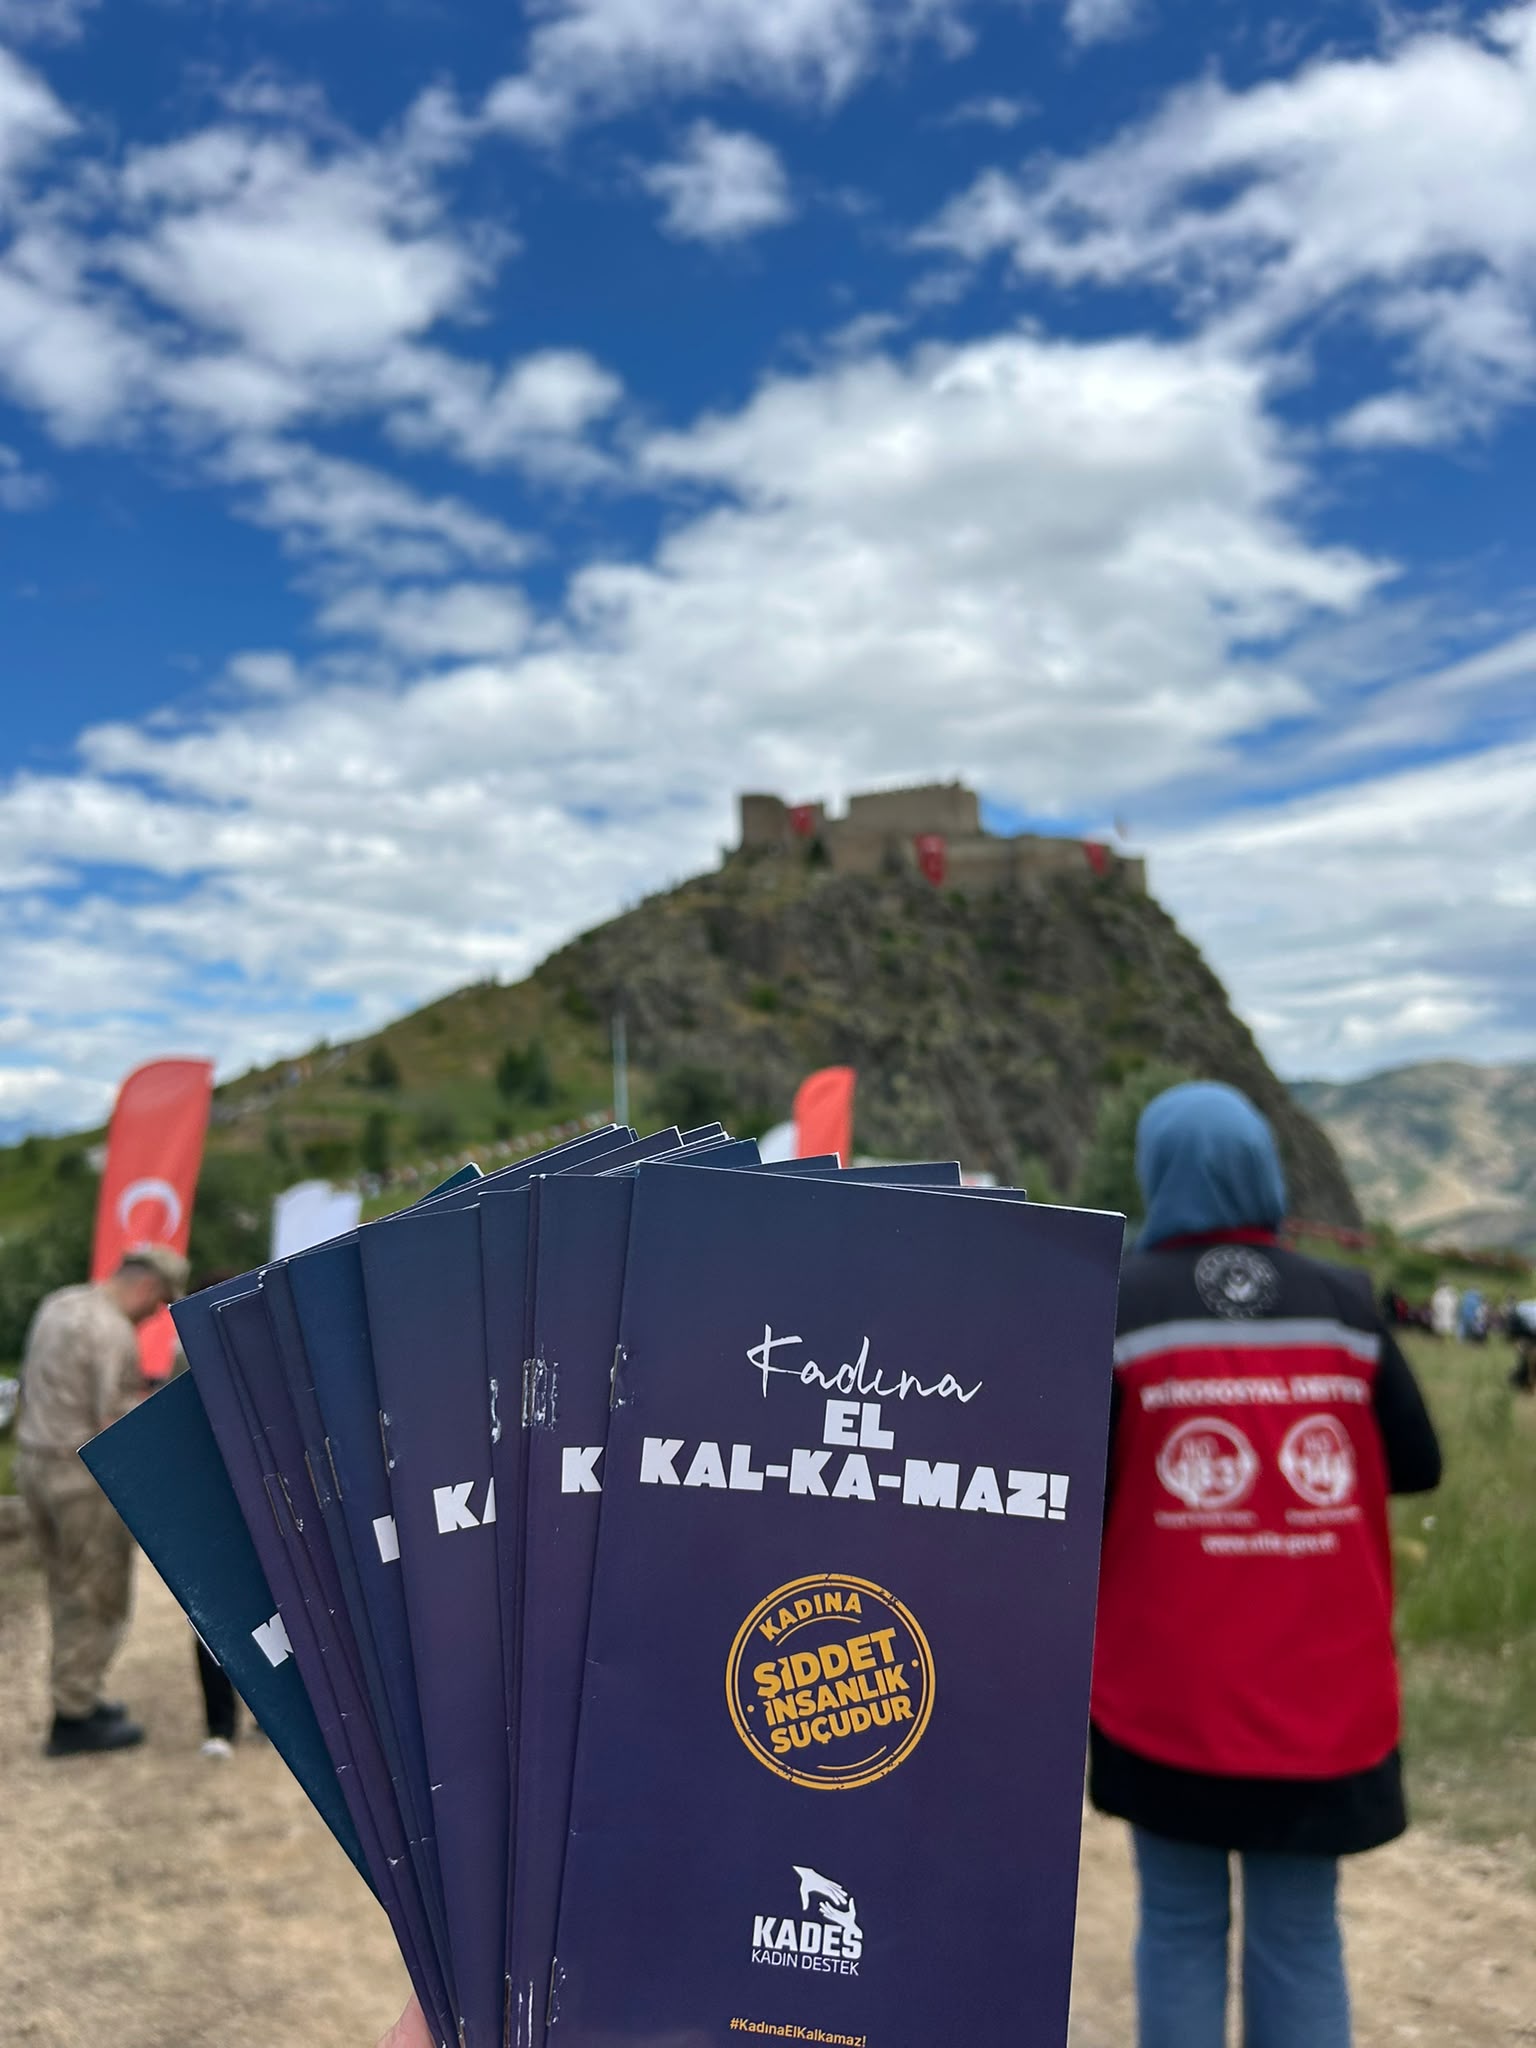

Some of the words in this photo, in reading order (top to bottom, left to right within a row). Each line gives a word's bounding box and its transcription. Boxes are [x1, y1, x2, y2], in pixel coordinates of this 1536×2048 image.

[747, 1324, 982, 1402] Kadına
[823, 1399, 895, 1450] EL
[640, 1437, 1070, 1521] KAL-KA-MAZ!
[758, 1592, 862, 1641] KADINA
[753, 1627, 896, 1698] ŞİDDET
[763, 1664, 910, 1726] İNSANLIK
[770, 1695, 915, 1754] SUÇUDUR
[751, 1949, 798, 1968] KADIN
[801, 1955, 859, 1976] DESTEK
[752, 1915, 863, 1960] KADES
[729, 2017, 867, 2047] #KadınaElKalkamaz!
